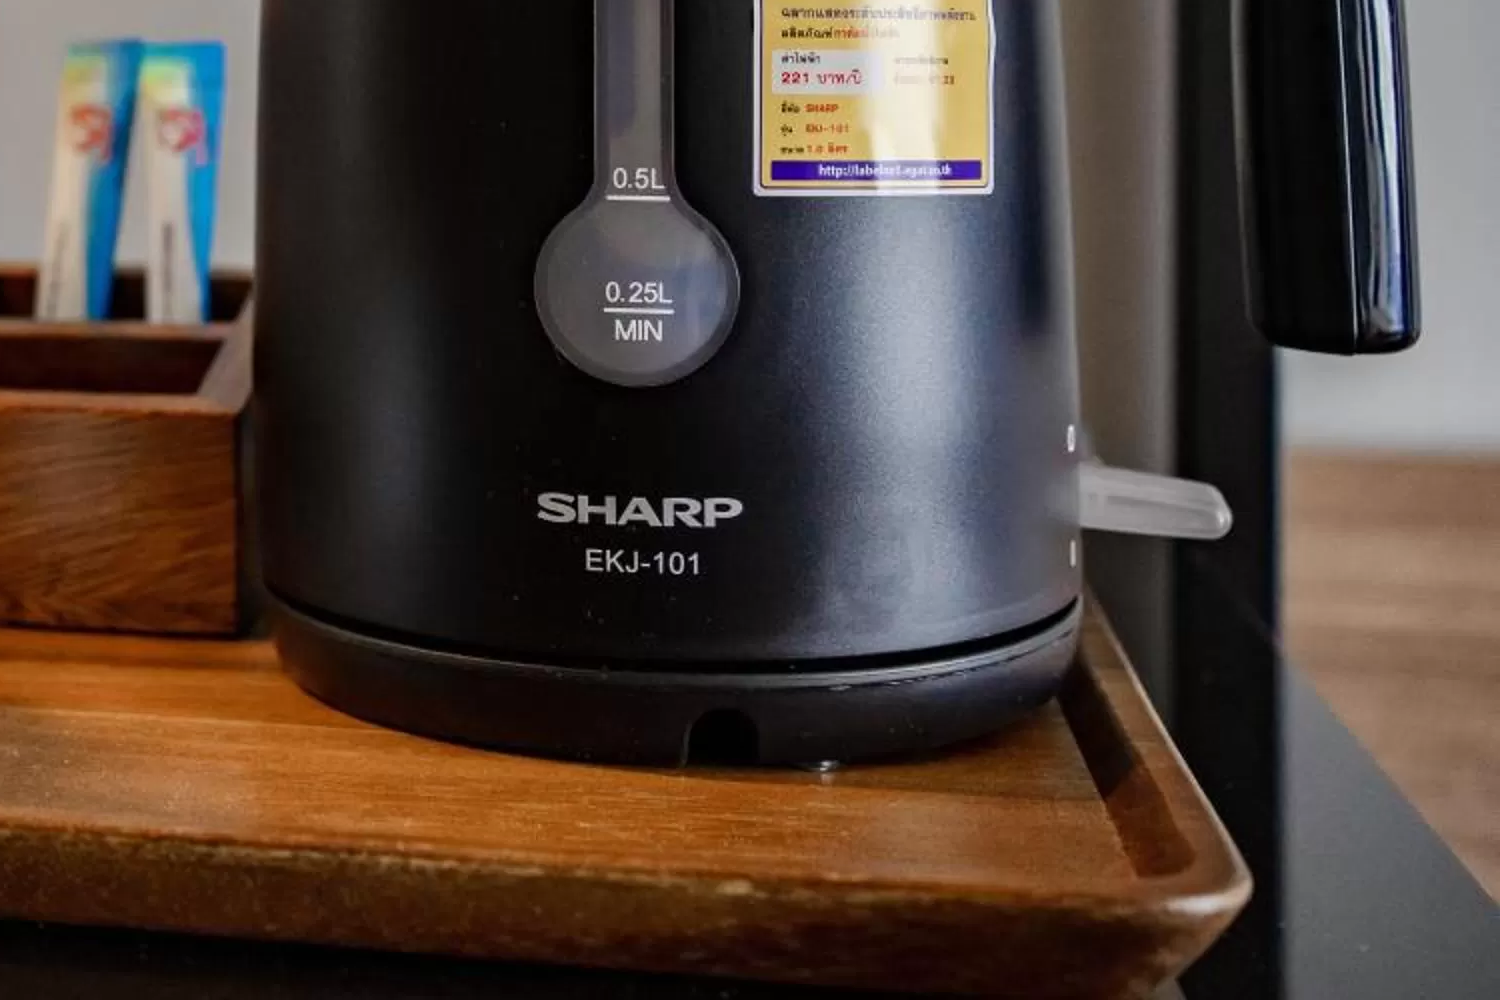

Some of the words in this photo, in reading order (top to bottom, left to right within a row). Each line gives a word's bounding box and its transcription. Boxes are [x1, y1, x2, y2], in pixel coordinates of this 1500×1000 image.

[780, 71, 810, 85] 221
[804, 103, 840, 114] SHARP
[612, 168, 665, 190] 0.5L
[605, 281, 673, 304] 0.25L
[614, 319, 663, 341] MIN
[537, 492, 743, 527] SHARP
[585, 548, 700, 575] EKJ-101
